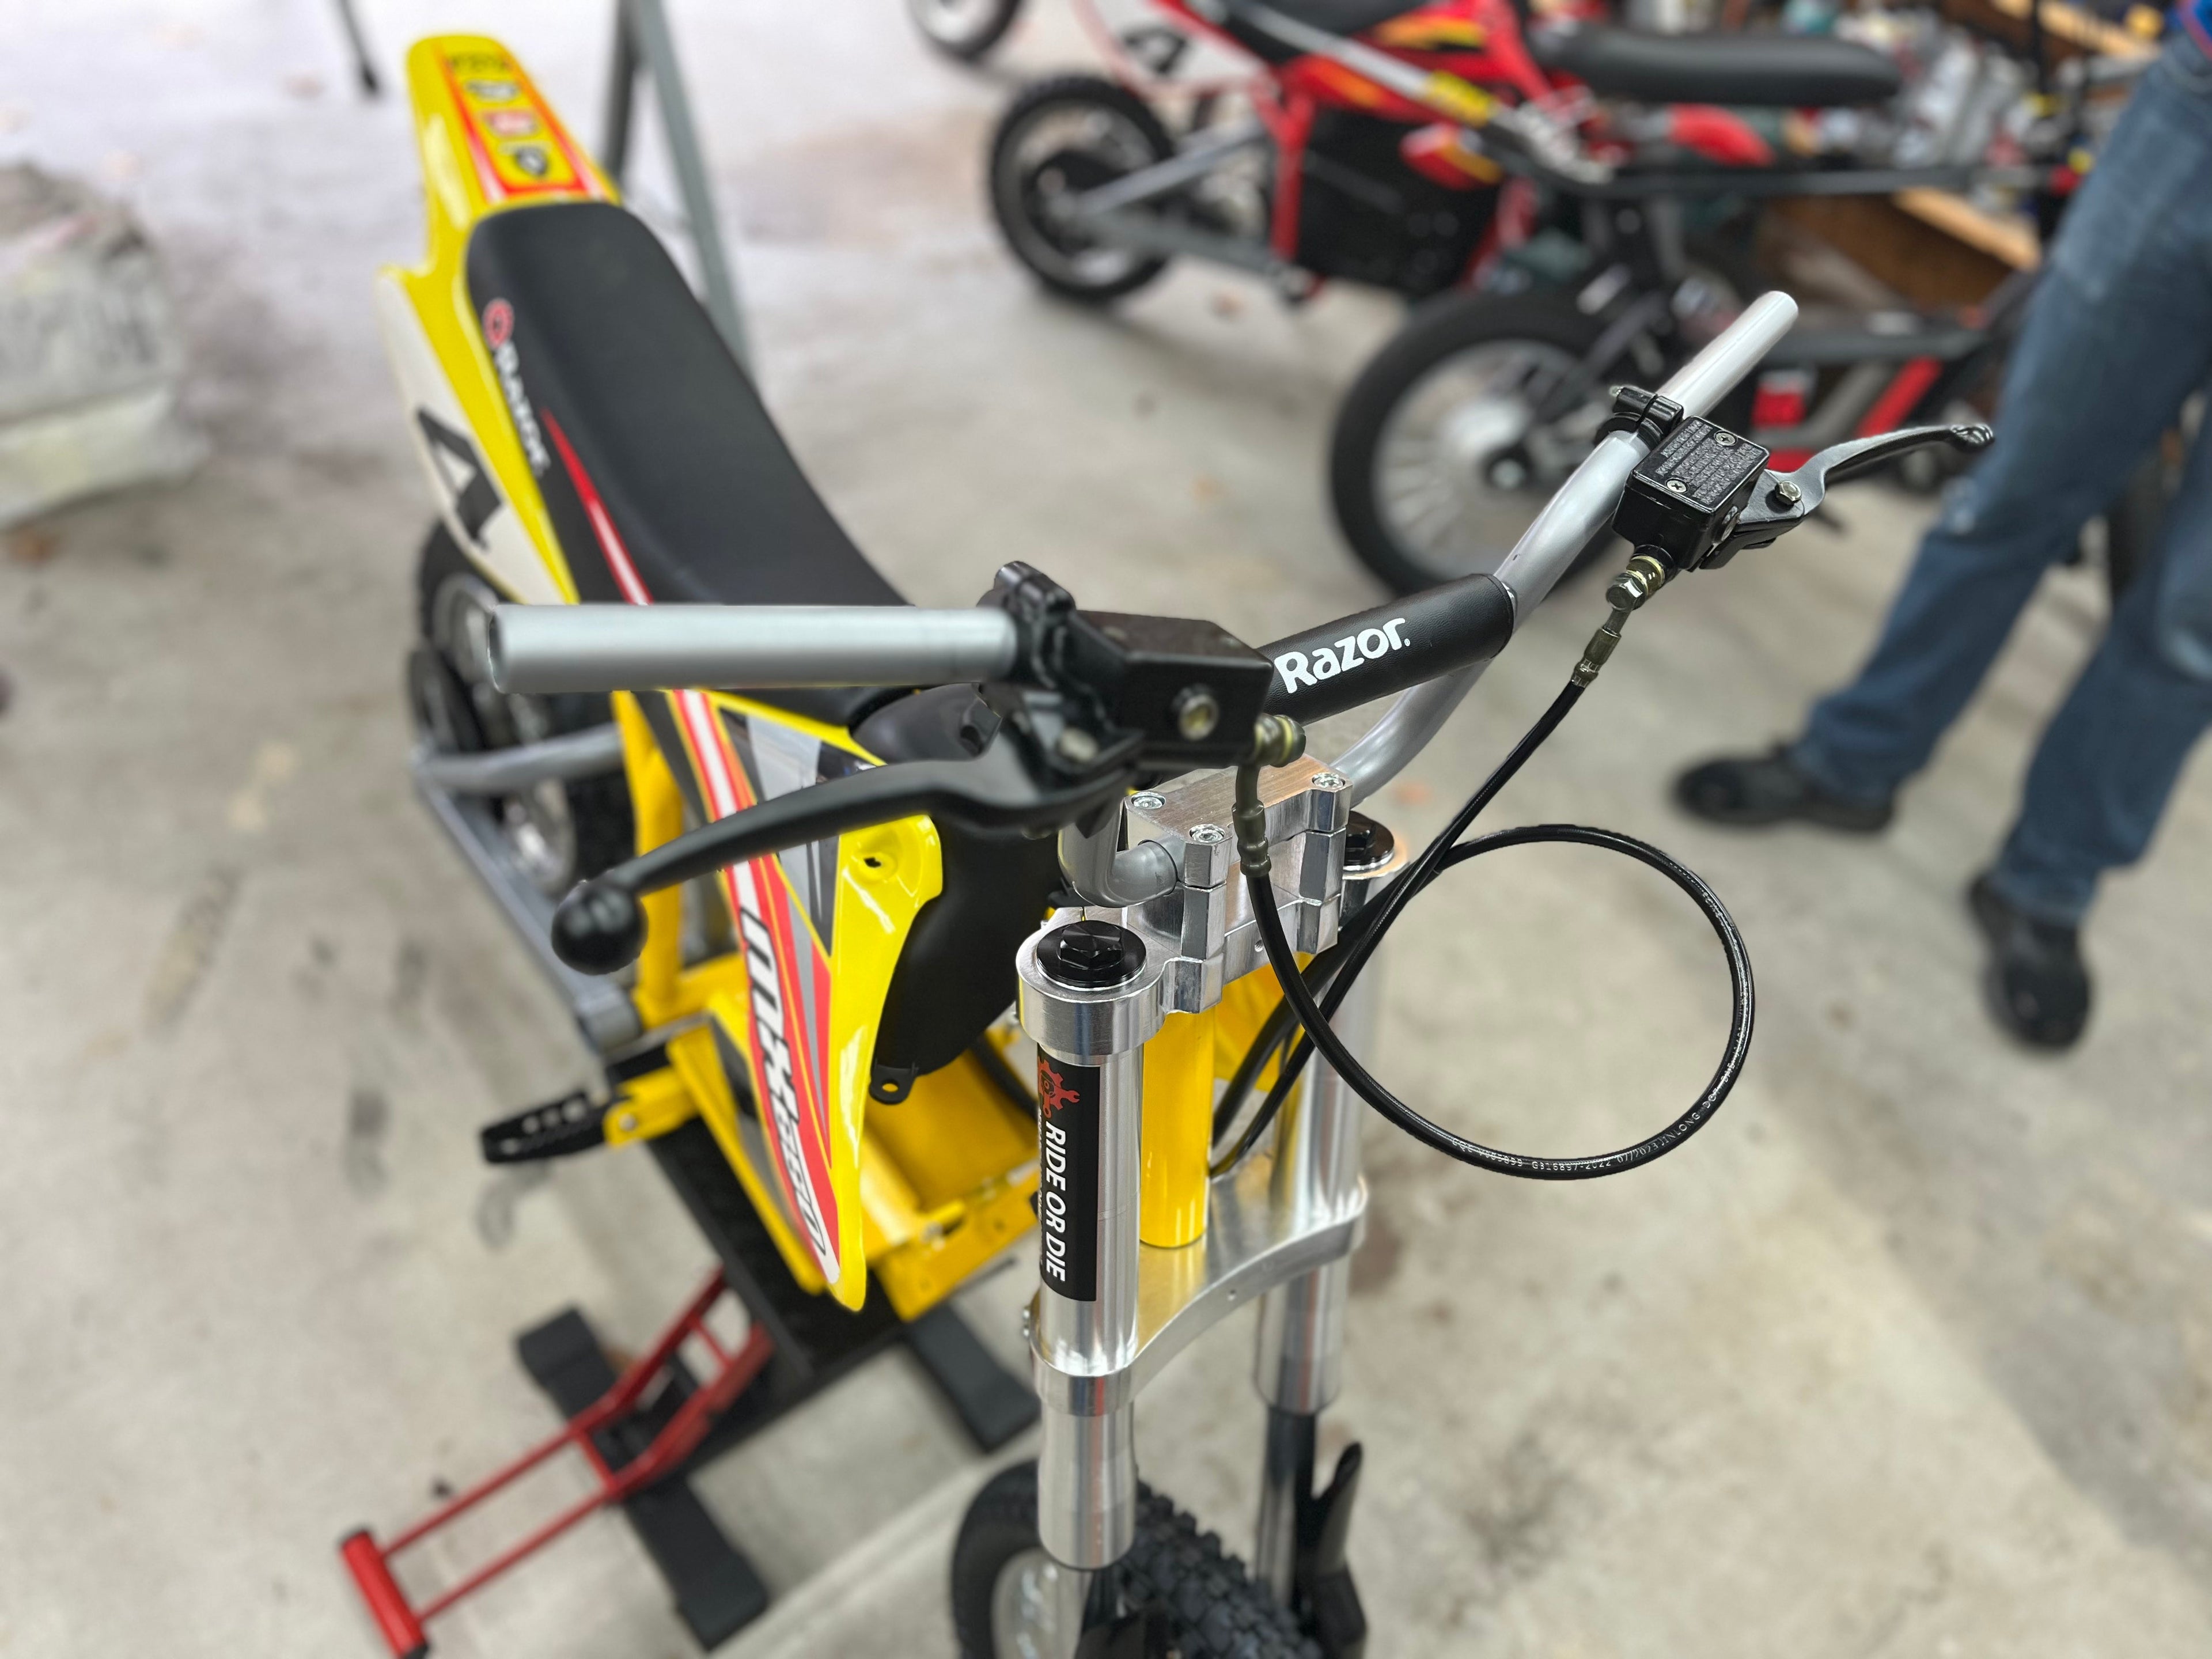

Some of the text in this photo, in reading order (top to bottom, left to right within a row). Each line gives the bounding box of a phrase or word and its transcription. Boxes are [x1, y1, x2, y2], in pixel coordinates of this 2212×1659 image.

[1659, 1112, 1700, 1146] JINLONG
[1046, 1121, 1066, 1282] RIDE OR DIE
